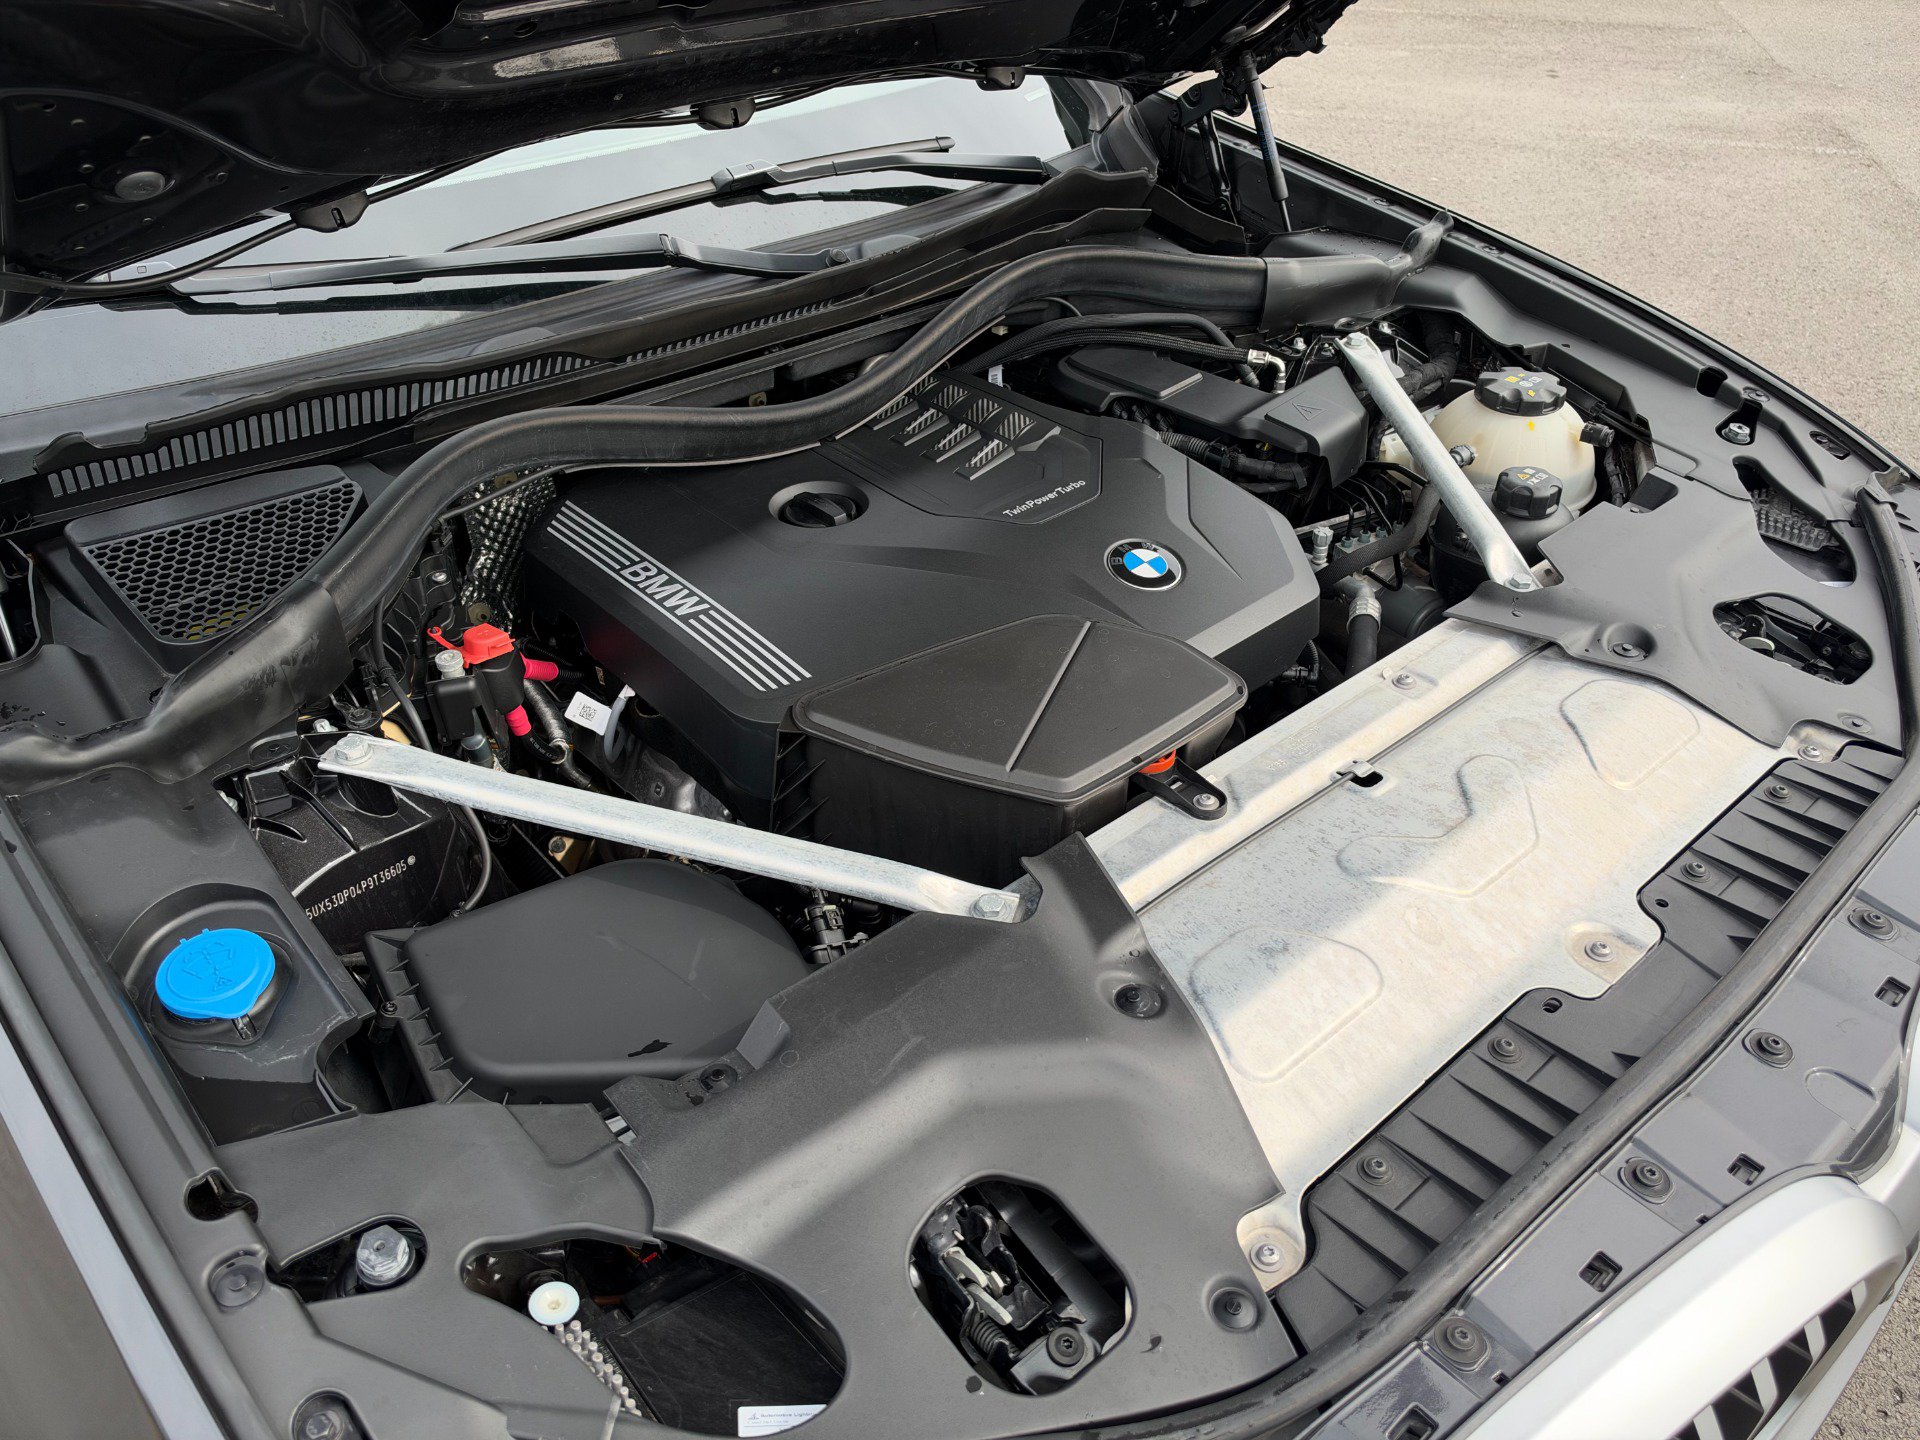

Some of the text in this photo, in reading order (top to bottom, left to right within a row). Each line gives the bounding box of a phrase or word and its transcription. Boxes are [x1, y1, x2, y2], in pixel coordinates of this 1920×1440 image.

[1002, 480, 1086, 517] TwinPowerTurbo
[620, 561, 711, 616] BMW
[305, 860, 407, 920] 5UX53DP04P9T36605
